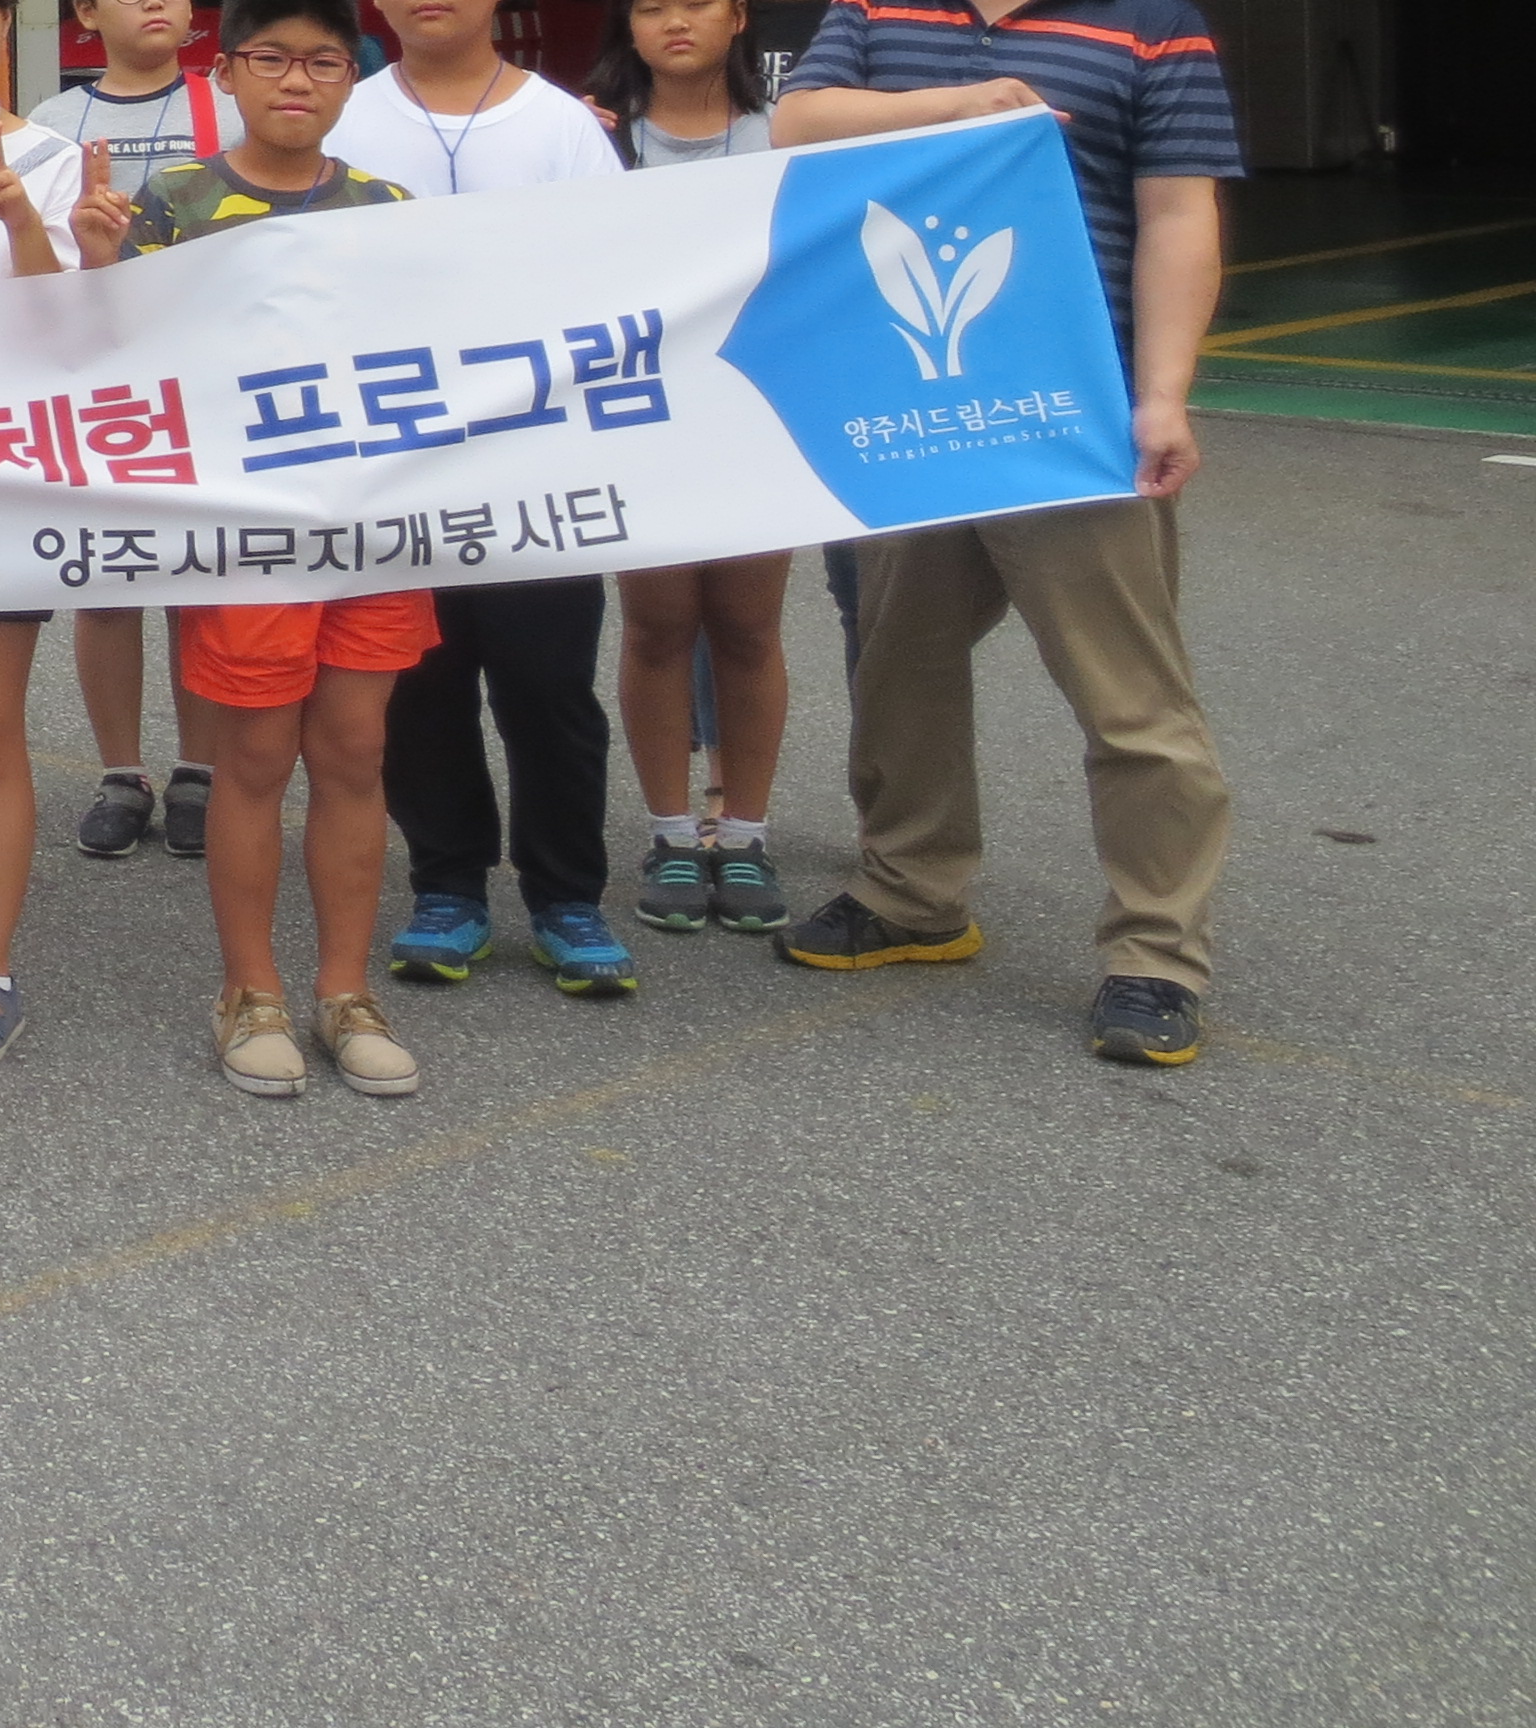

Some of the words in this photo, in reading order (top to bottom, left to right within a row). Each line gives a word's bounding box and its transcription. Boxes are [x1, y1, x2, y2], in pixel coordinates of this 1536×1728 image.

[122, 142, 131, 153] A
[132, 141, 153, 153] LOT
[154, 140, 167, 152] OF
[237, 308, 671, 473] 프로그램
[843, 390, 1082, 449] 양주시드림스타트
[859, 443, 940, 464] Yangju
